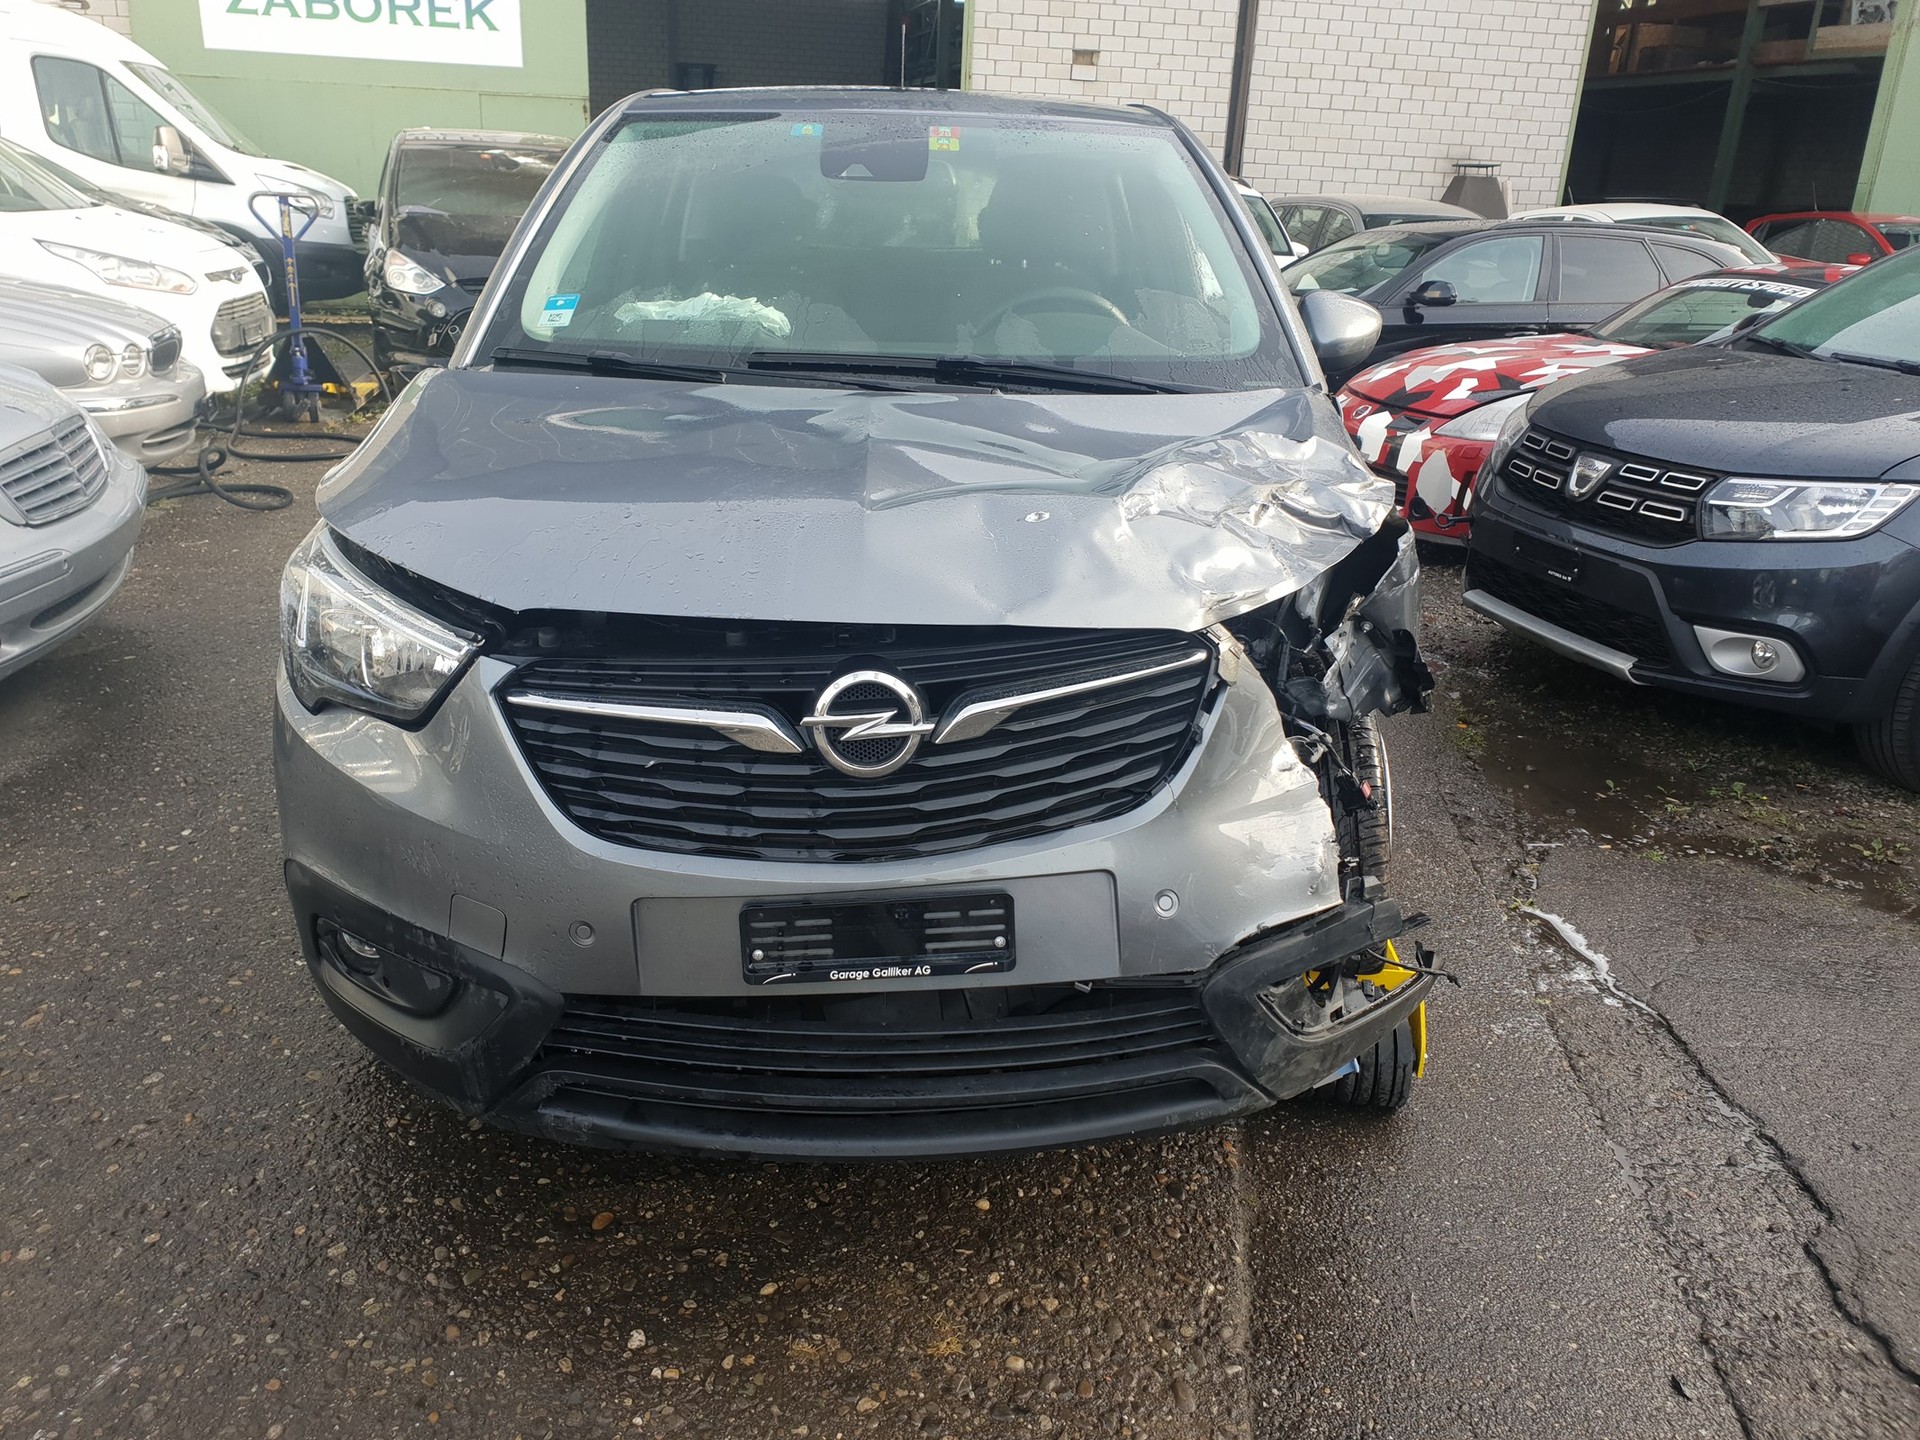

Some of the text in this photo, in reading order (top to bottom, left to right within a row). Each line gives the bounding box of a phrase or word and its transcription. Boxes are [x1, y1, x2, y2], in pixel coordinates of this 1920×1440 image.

[833, 672, 897, 689] OPEL
[829, 965, 931, 980] Garage Galliker AG
